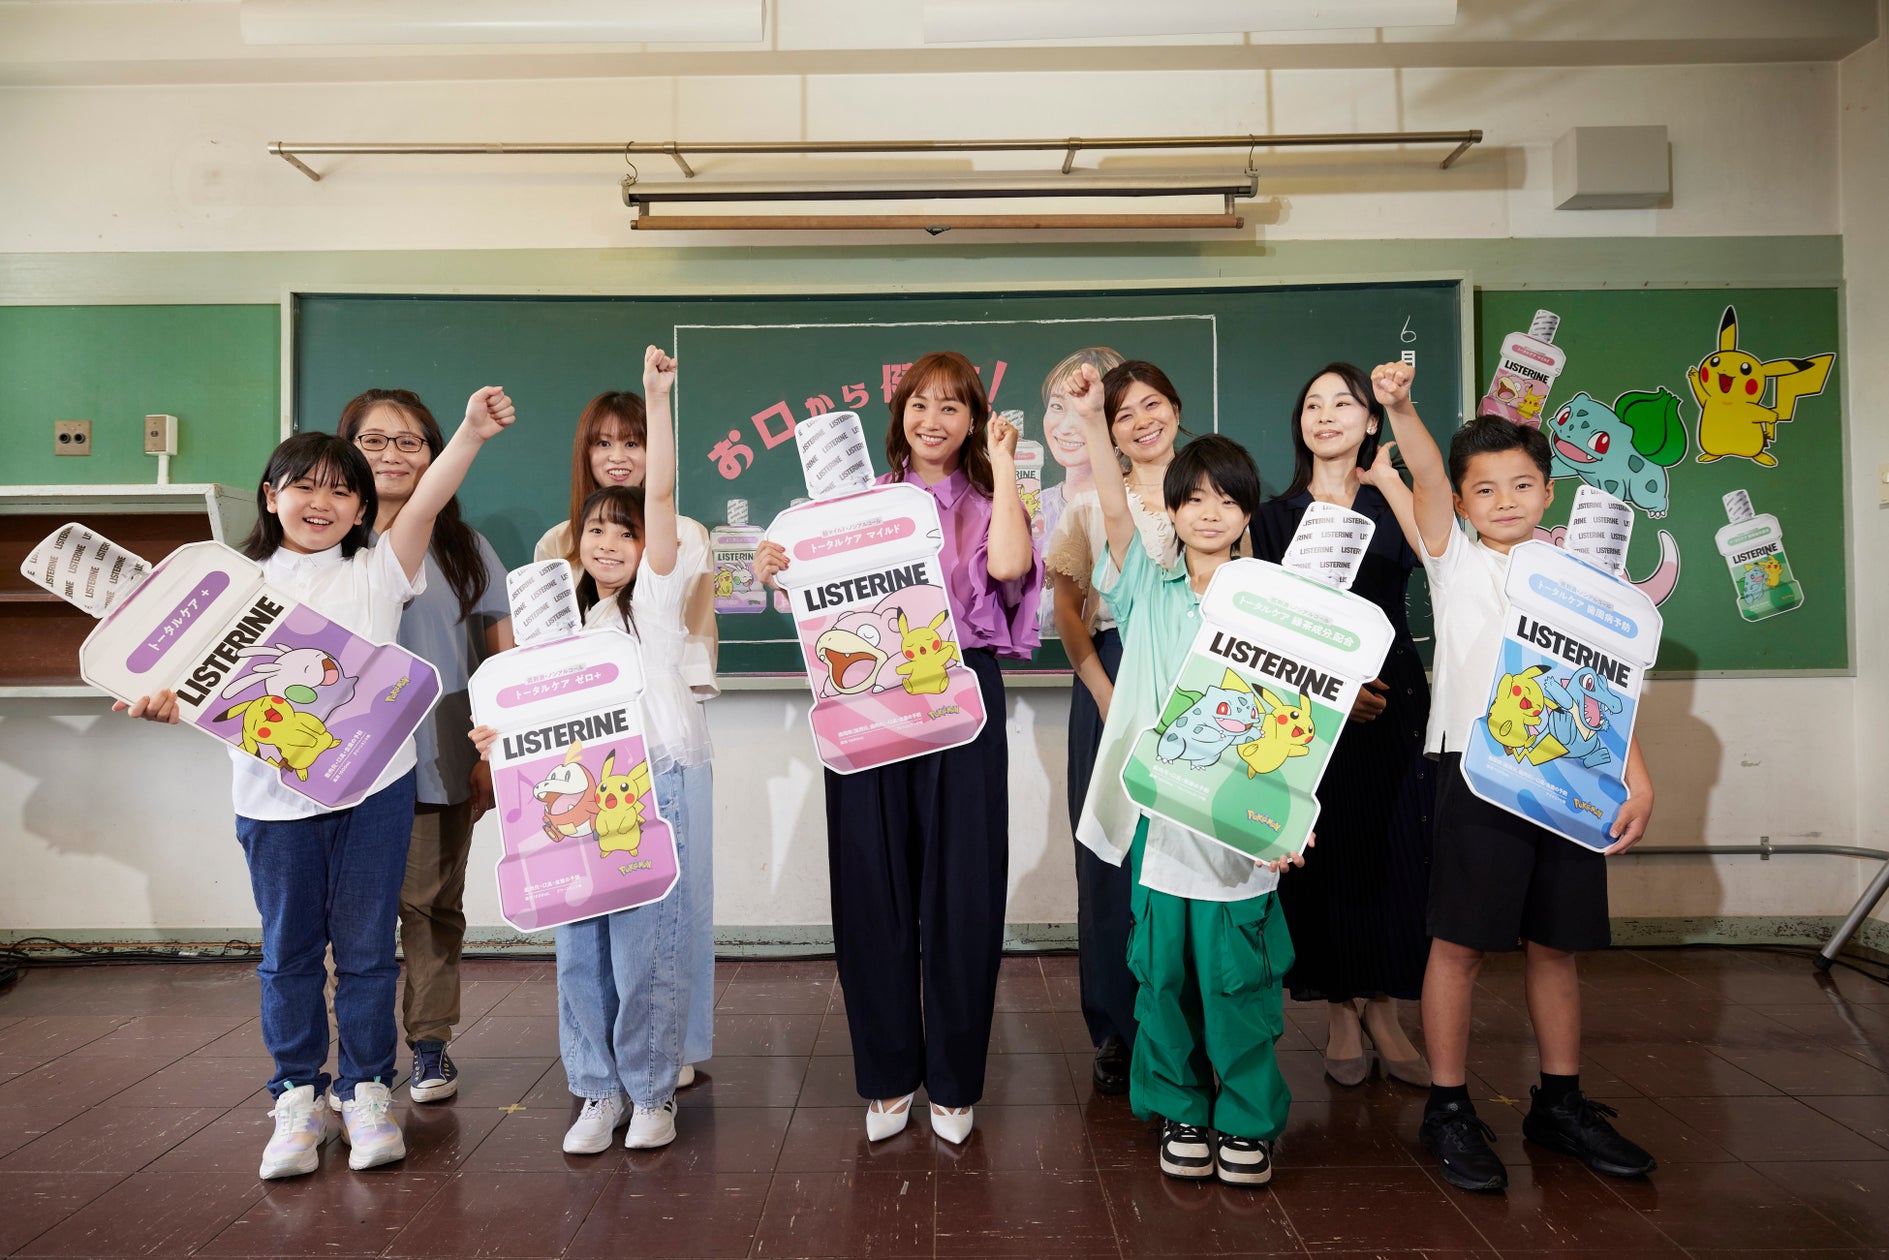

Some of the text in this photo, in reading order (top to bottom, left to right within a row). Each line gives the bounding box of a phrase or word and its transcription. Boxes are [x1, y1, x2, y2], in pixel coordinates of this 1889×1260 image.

[1504, 360, 1550, 384] LISTERINE
[822, 432, 848, 453] LISTERINE
[816, 456, 843, 480] LISTERINE
[840, 460, 865, 480] LISTERINE
[1593, 516, 1619, 525] LISTERINE
[811, 523, 900, 553] トータルケア マイルド
[1578, 531, 1605, 540] LISTERINE
[68, 544, 86, 574] LISTERINE
[718, 553, 754, 561] LISTERIN
[1300, 546, 1334, 555] LISTERINE
[1596, 547, 1621, 555] LISTERINE
[1732, 543, 1778, 564] LISTERINE
[85, 566, 100, 598] LISTERINE
[109, 556, 126, 584] LISTERINE
[531, 579, 557, 600] LISTERINE
[804, 562, 930, 612] LISTERINE
[1537, 580, 1584, 607] トータルケア
[523, 602, 550, 627] LISTERINE
[545, 606, 572, 627] LISTERINE
[1238, 595, 1290, 621] トータルケア
[148, 598, 198, 651] トータルケア
[176, 595, 284, 707] LISTERINE
[1516, 615, 1631, 689] LISTERINE
[1209, 631, 1344, 702] LISTERINE
[516, 679, 570, 700] トータルケア
[502, 708, 629, 761] LISTERINE
